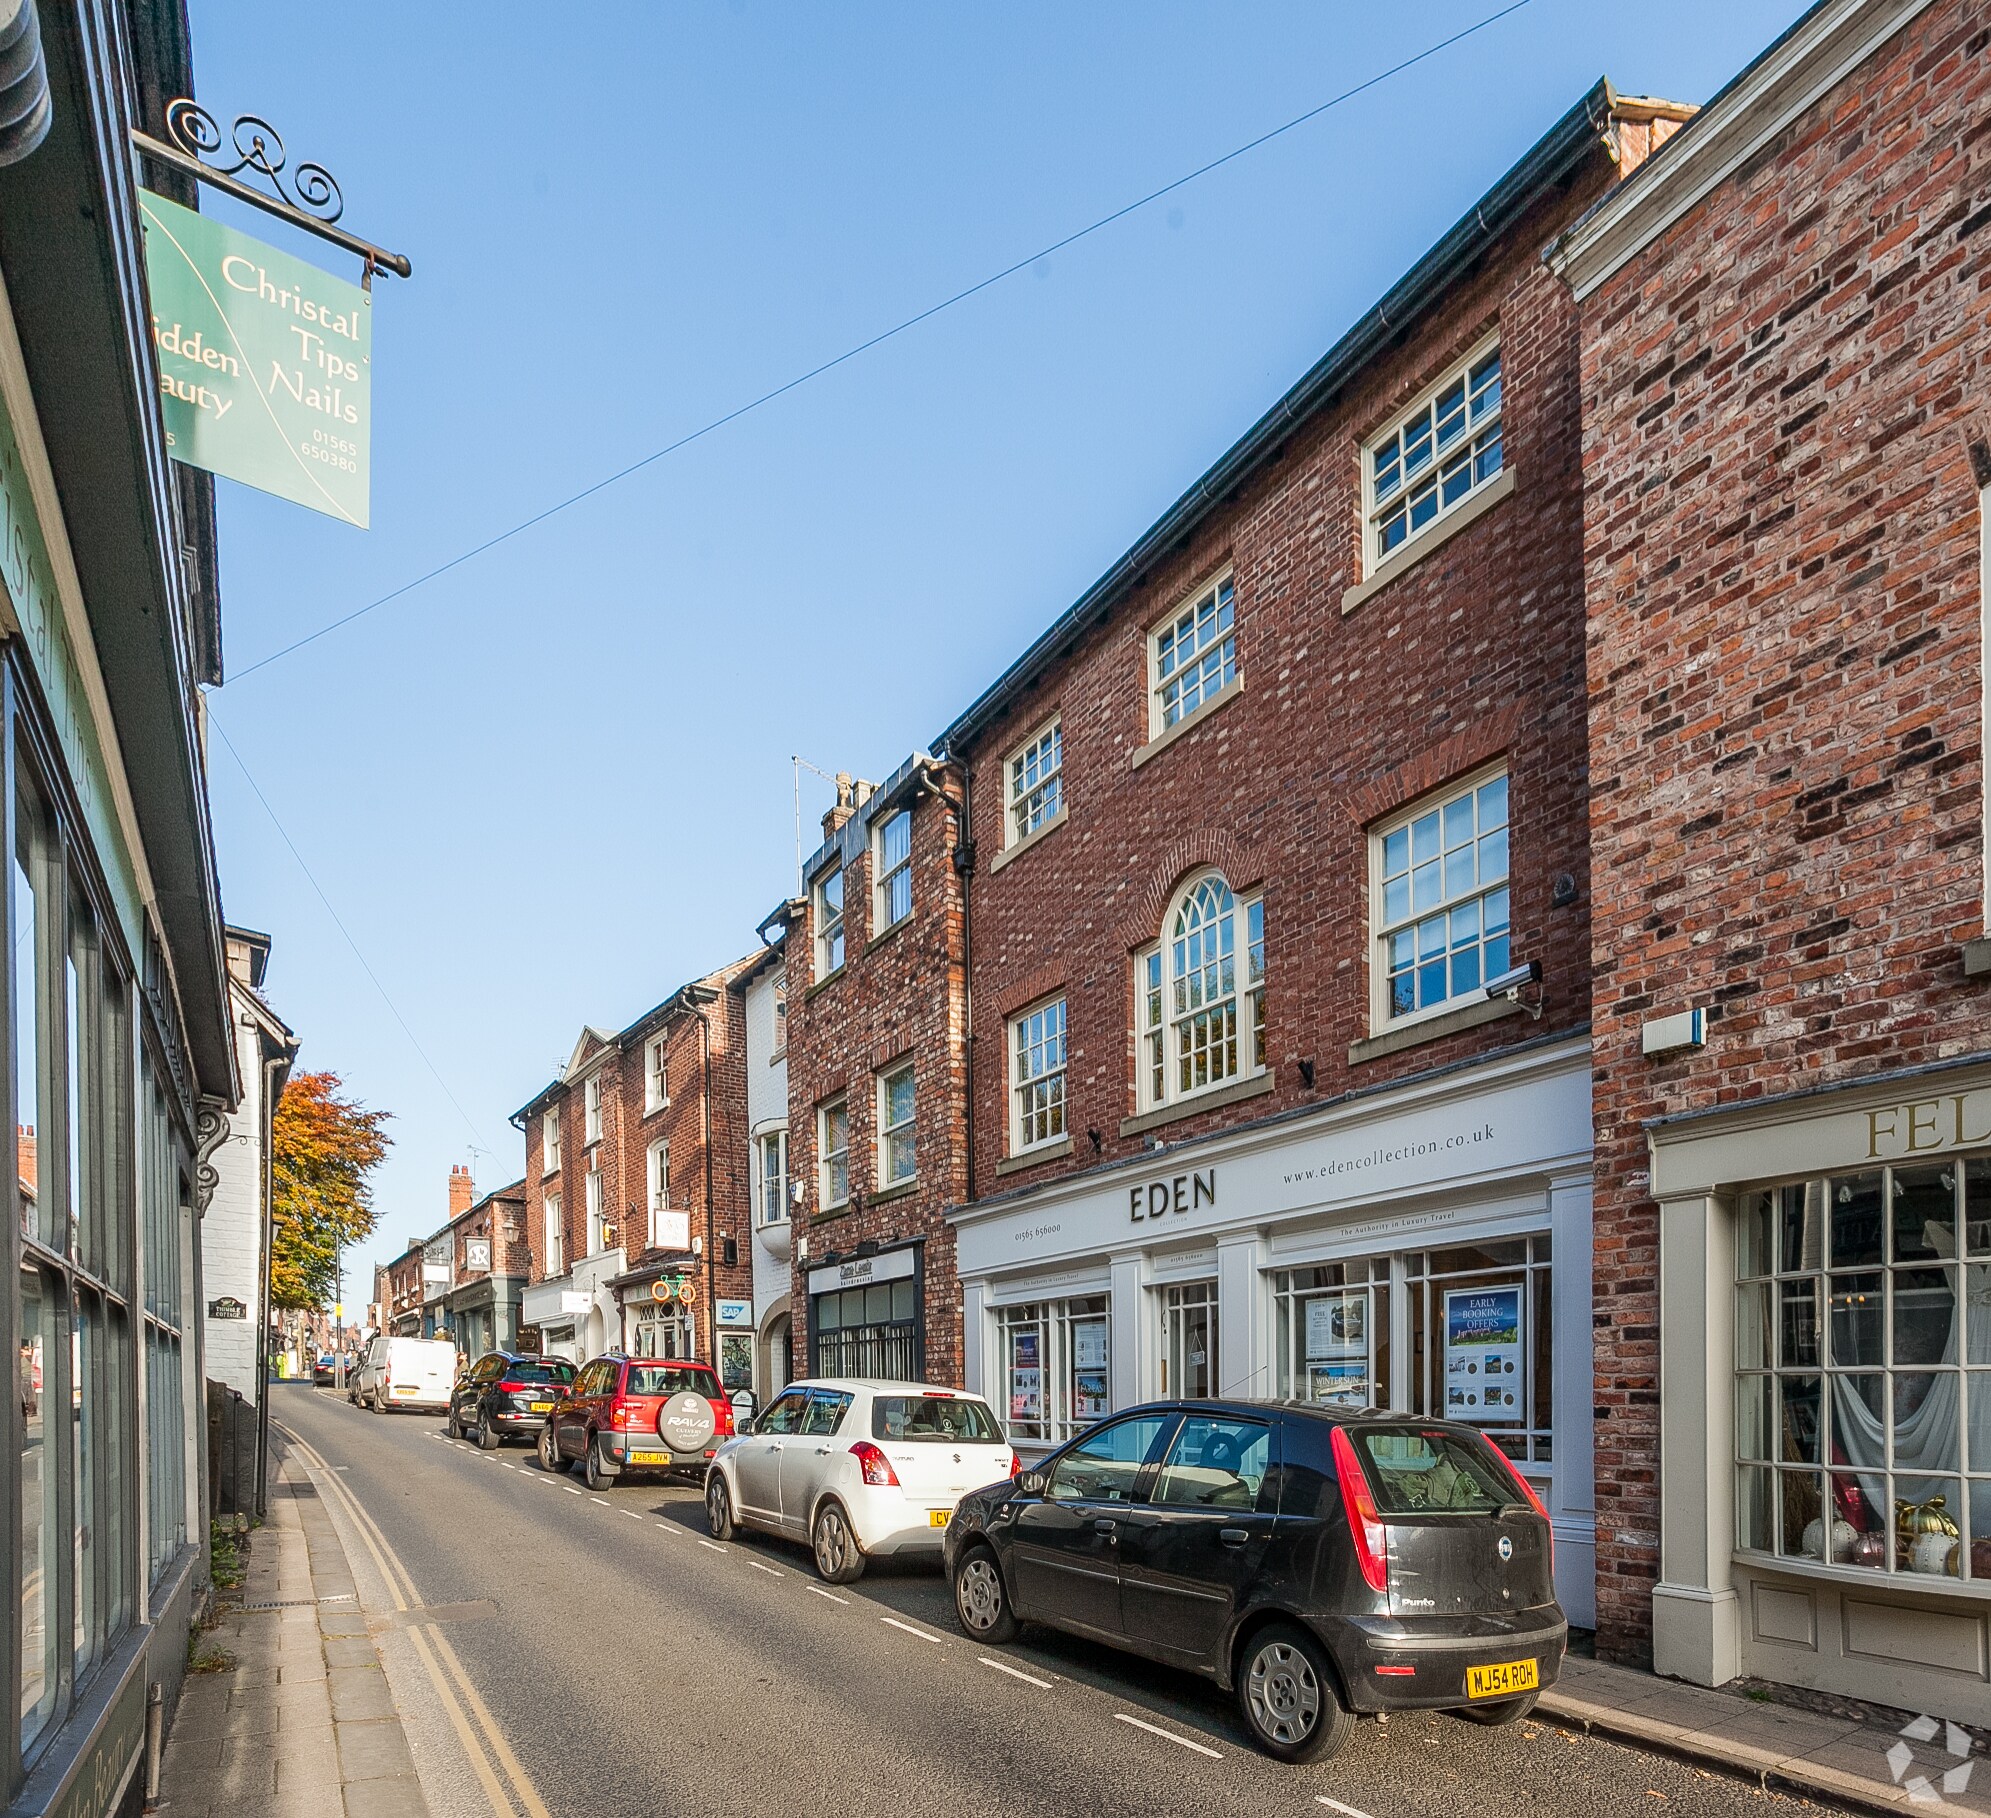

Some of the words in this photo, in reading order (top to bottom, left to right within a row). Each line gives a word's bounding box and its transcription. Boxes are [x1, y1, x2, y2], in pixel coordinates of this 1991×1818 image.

[221, 255, 360, 341] Christal
[153, 316, 241, 378] idden
[290, 325, 359, 382] Tips
[160, 374, 233, 420] auty
[268, 360, 359, 424] Nails
[165, 432, 176, 446] 5
[313, 429, 357, 456] 01565
[301, 442, 357, 474] 650380
[0, 449, 54, 691] istal
[1283, 1124, 1495, 1185] www.edencollection.co.uk
[1129, 1168, 1215, 1222] EDEN
[1014, 1229, 1033, 1242] 01565
[1035, 1223, 1062, 1238] 656000
[1341, 1228, 1353, 1237] The
[1355, 1222, 1389, 1235] Authority
[1391, 1220, 1399, 1229] in
[1402, 1216, 1428, 1227] Luxury
[1430, 1210, 1455, 1222] Travel
[722, 1308, 741, 1318] SAP
[1462, 1307, 1504, 1319] BOOKING
[1470, 1297, 1497, 1308] EARLY
[1466, 1319, 1499, 1329] OFFERS
[1315, 1376, 1343, 1385] WINTER
[1344, 1375, 1360, 1384] SUN
[667, 1416, 710, 1429] RAV4
[632, 1453, 652, 1461] A265
[936, 1512, 952, 1525] CV
[1401, 1598, 1436, 1607] Punto
[1473, 1668, 1509, 1693] MJ54
[1511, 1663, 1534, 1686] ROH
